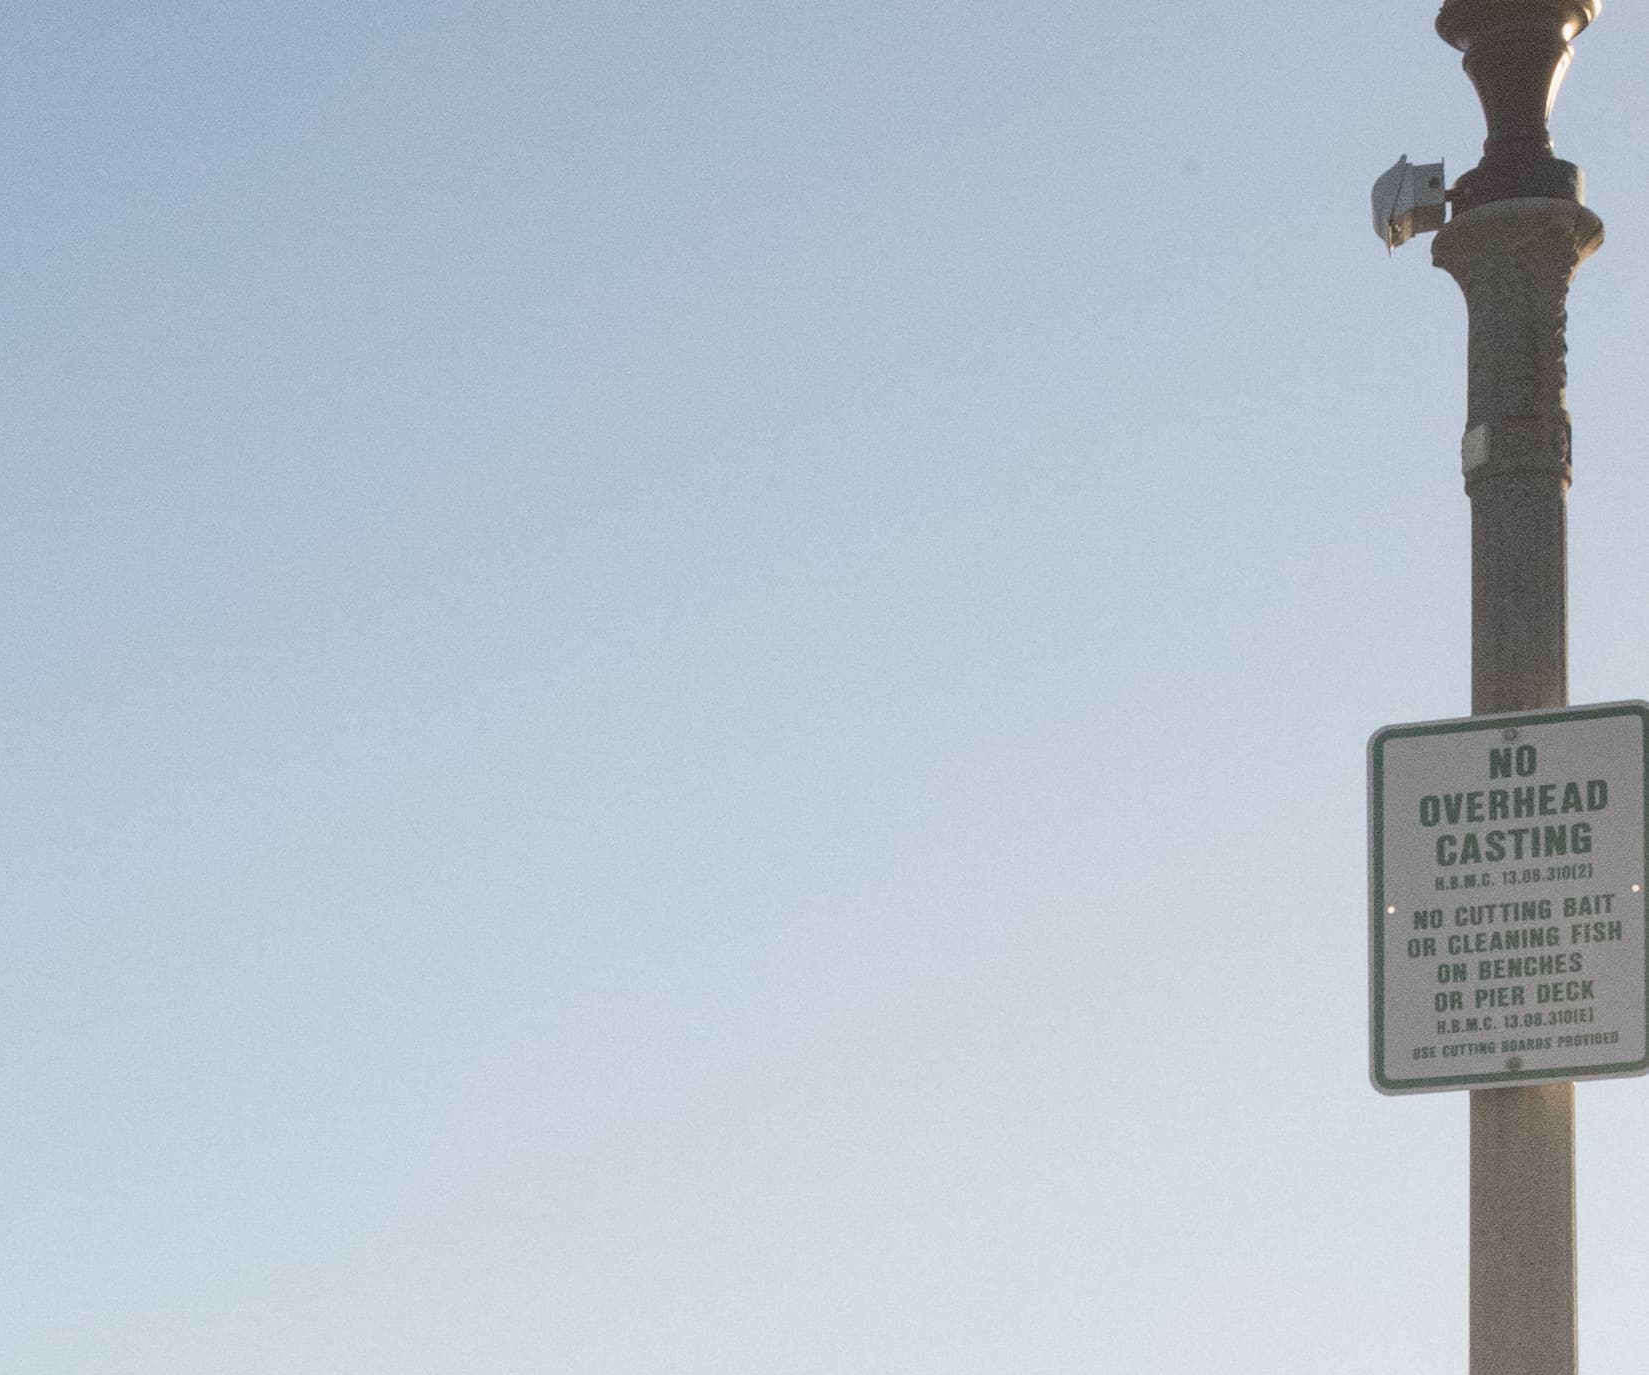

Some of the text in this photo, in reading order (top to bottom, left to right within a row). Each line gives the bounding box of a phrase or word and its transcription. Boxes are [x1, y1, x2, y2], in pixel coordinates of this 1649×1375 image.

[1489, 745, 1537, 779] NO
[1419, 779, 1609, 827] OVERHEAD
[1436, 822, 1592, 866] CASTING
[1435, 873, 1495, 891] H.B.M.C.
[1413, 894, 1615, 930] NO CUTTING BAIT
[1407, 920, 1622, 958] OR CLEANING FISH
[1437, 952, 1583, 983] ON BENCHES
[1435, 980, 1595, 1012] OR PIER DECK
[1437, 1016, 1496, 1035] H.B.M.C.
[1412, 1031, 1619, 1060] USE CUTTING BOARDS PROVIDED
